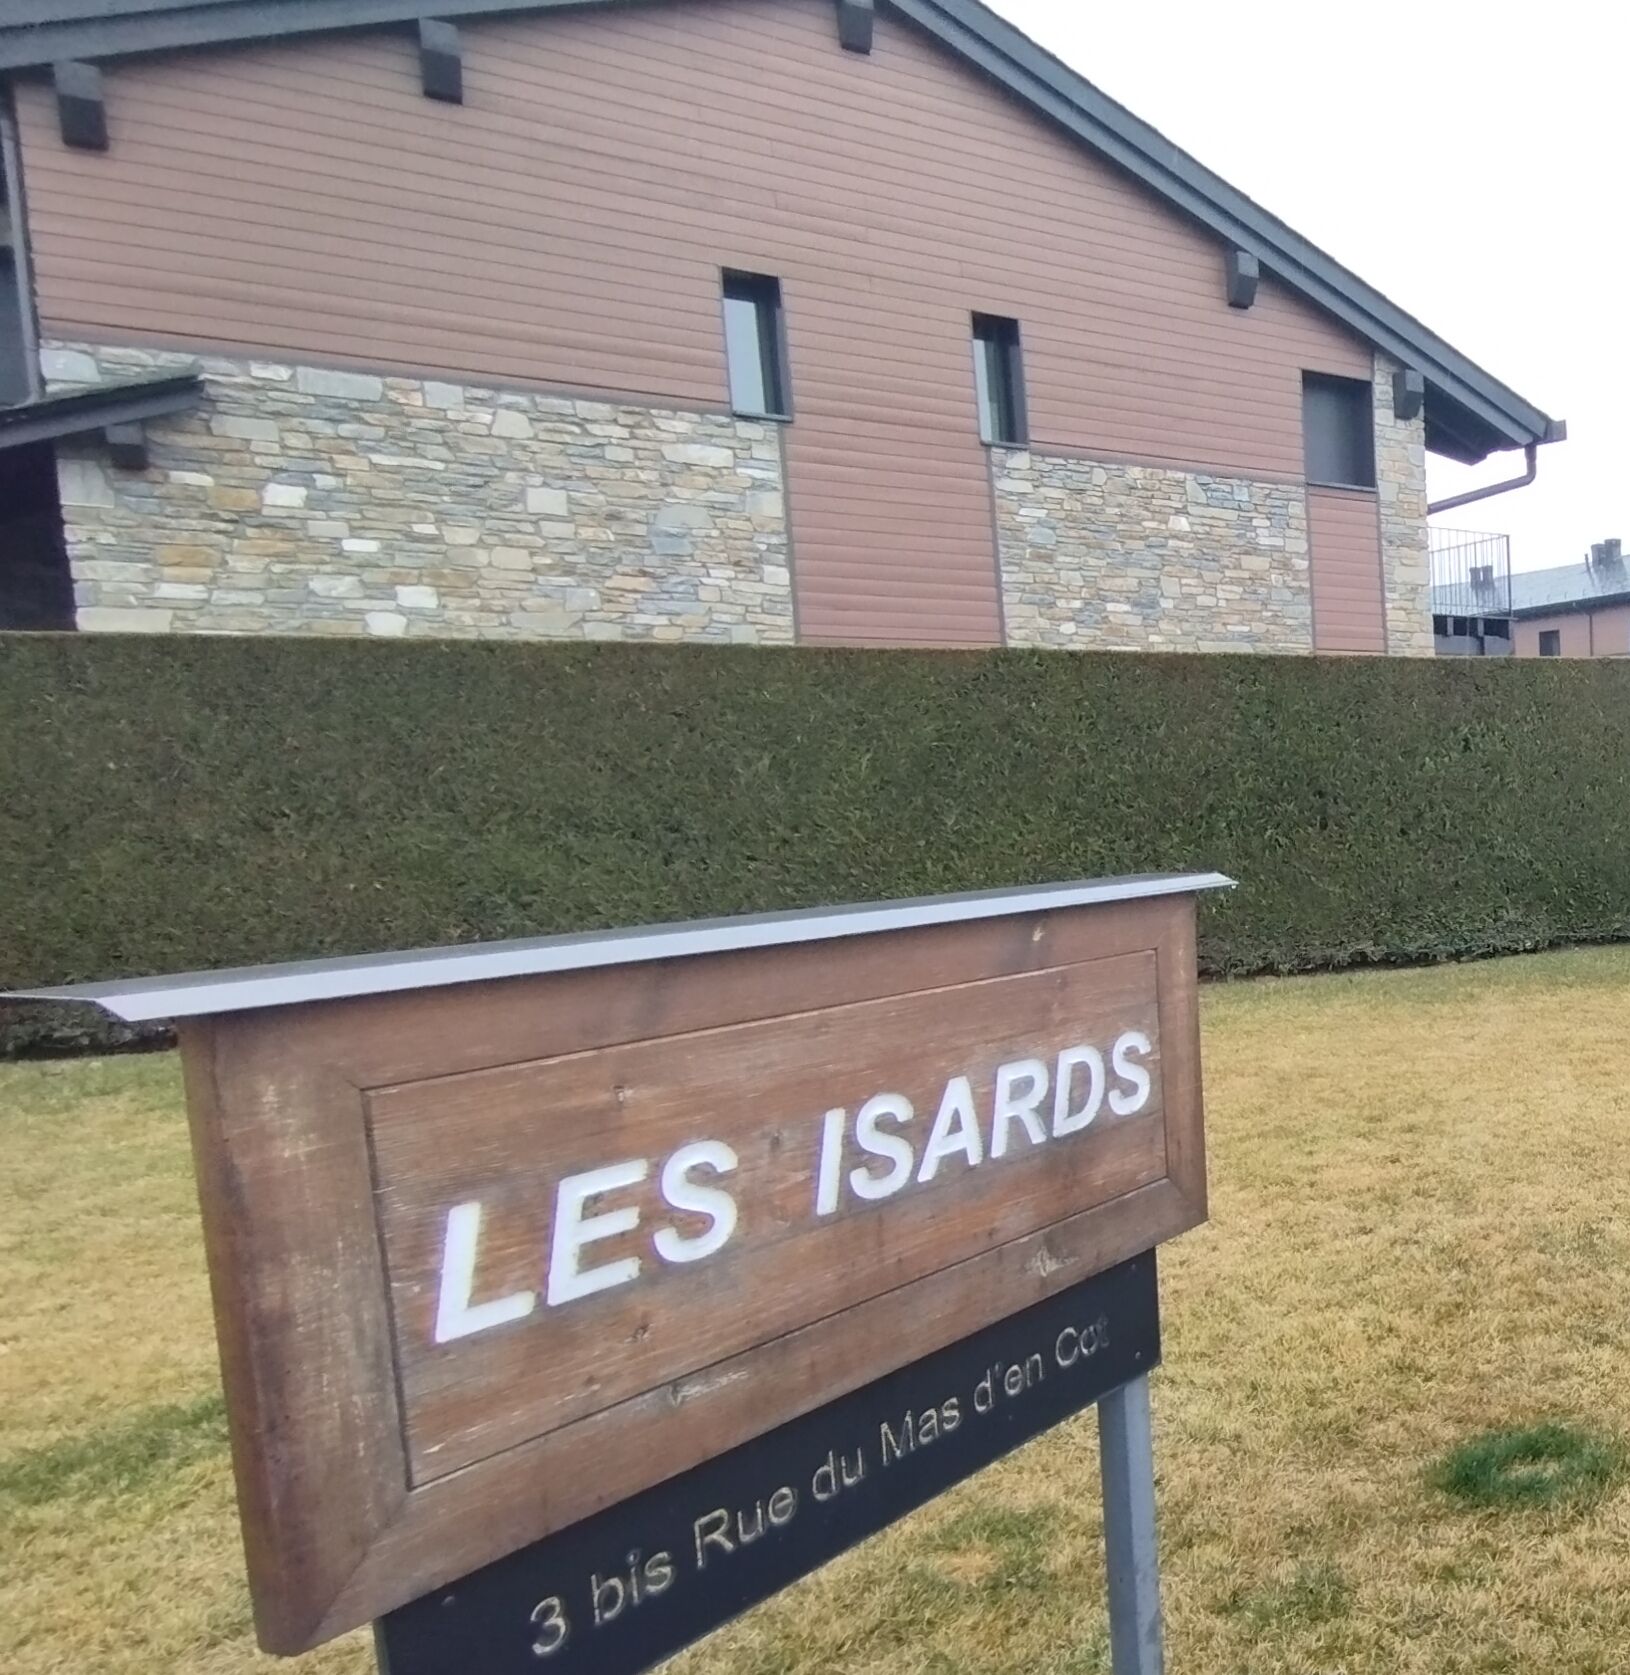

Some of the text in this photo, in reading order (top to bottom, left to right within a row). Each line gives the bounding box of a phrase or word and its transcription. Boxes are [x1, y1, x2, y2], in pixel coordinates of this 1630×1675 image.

[432, 1030, 1152, 1344] LES ISARDS
[529, 1595, 568, 1656] 3
[590, 1549, 674, 1624] bis
[692, 1486, 797, 1568] Rue
[812, 1447, 866, 1502] du
[880, 1396, 961, 1466] Mas
[973, 1352, 1043, 1414] d'en
